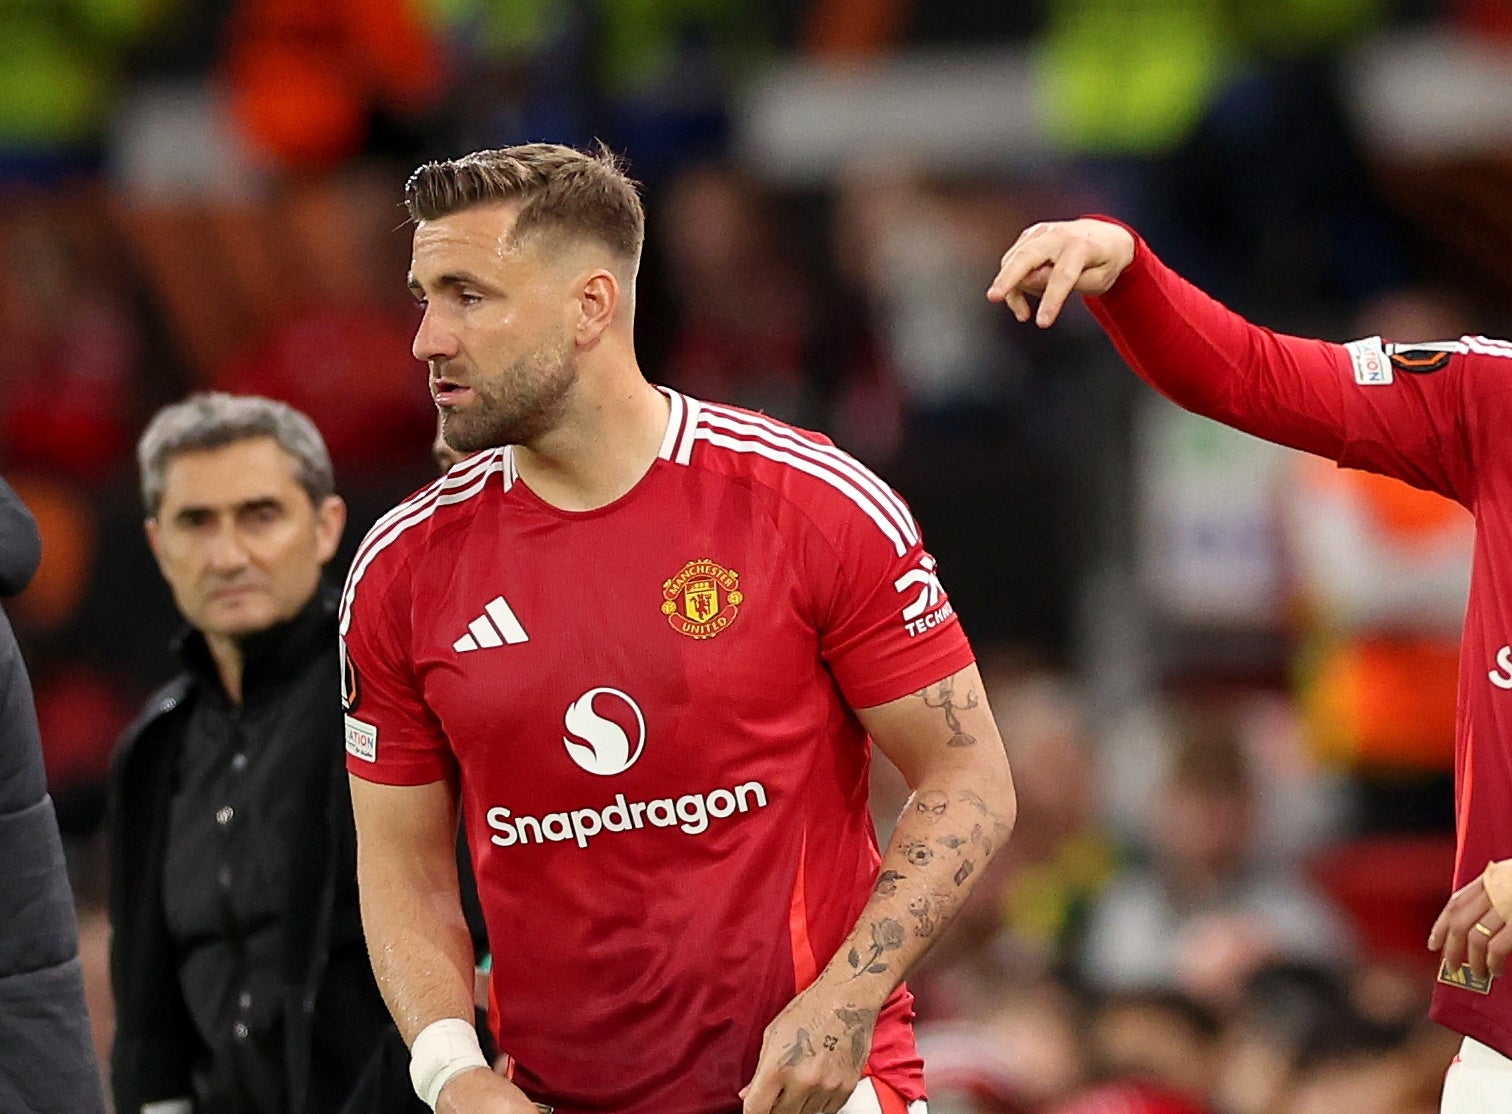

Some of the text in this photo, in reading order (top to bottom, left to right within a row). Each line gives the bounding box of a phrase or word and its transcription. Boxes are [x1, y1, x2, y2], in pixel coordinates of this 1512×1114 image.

[669, 565, 733, 594] MANCHESTER
[682, 617, 727, 634] UNITED
[486, 781, 767, 848] Snapdragon
